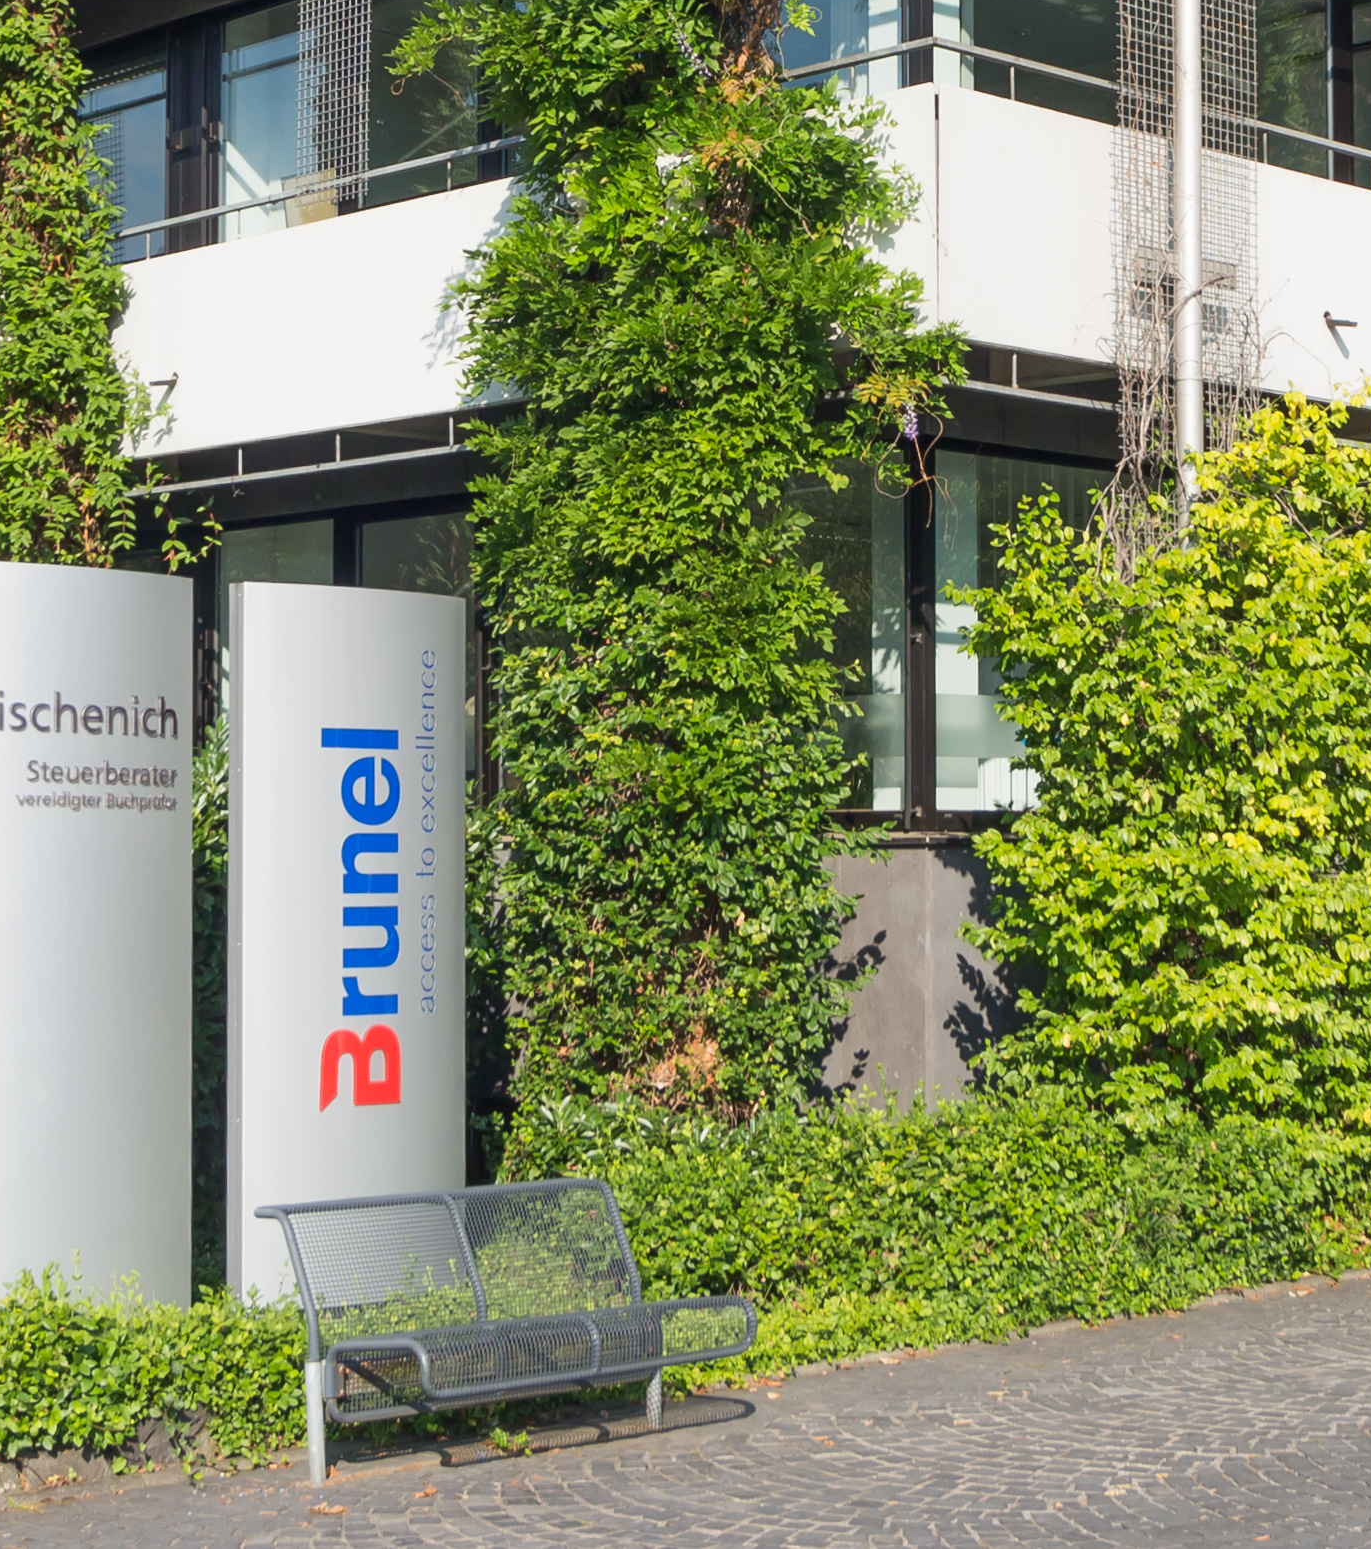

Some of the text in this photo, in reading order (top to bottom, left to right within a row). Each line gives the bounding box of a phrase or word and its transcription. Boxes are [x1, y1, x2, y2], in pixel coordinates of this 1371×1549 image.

[16, 791, 102, 812] vereidigter
[26, 760, 178, 788] Steuerberater
[415, 650, 437, 1013] access to excellence
[320, 727, 401, 1111] Brunel
